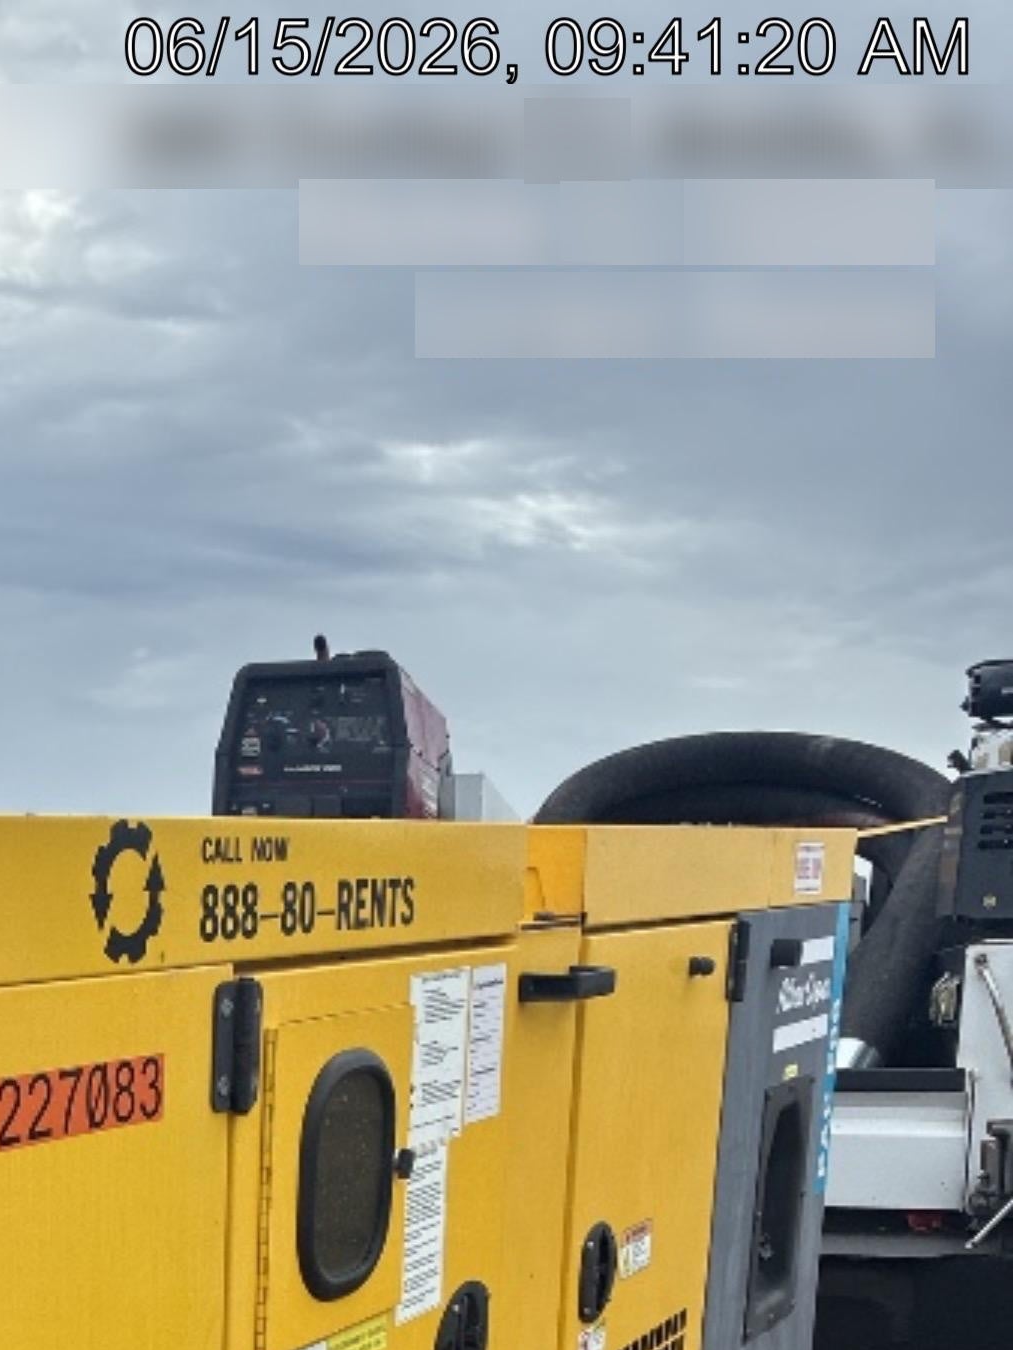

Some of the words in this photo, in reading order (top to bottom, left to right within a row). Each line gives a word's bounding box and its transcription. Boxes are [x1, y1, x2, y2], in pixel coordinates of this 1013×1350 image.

[201, 836, 243, 864] CALL
[251, 836, 290, 862] NOW
[199, 879, 415, 942] 888-80-RENTS
